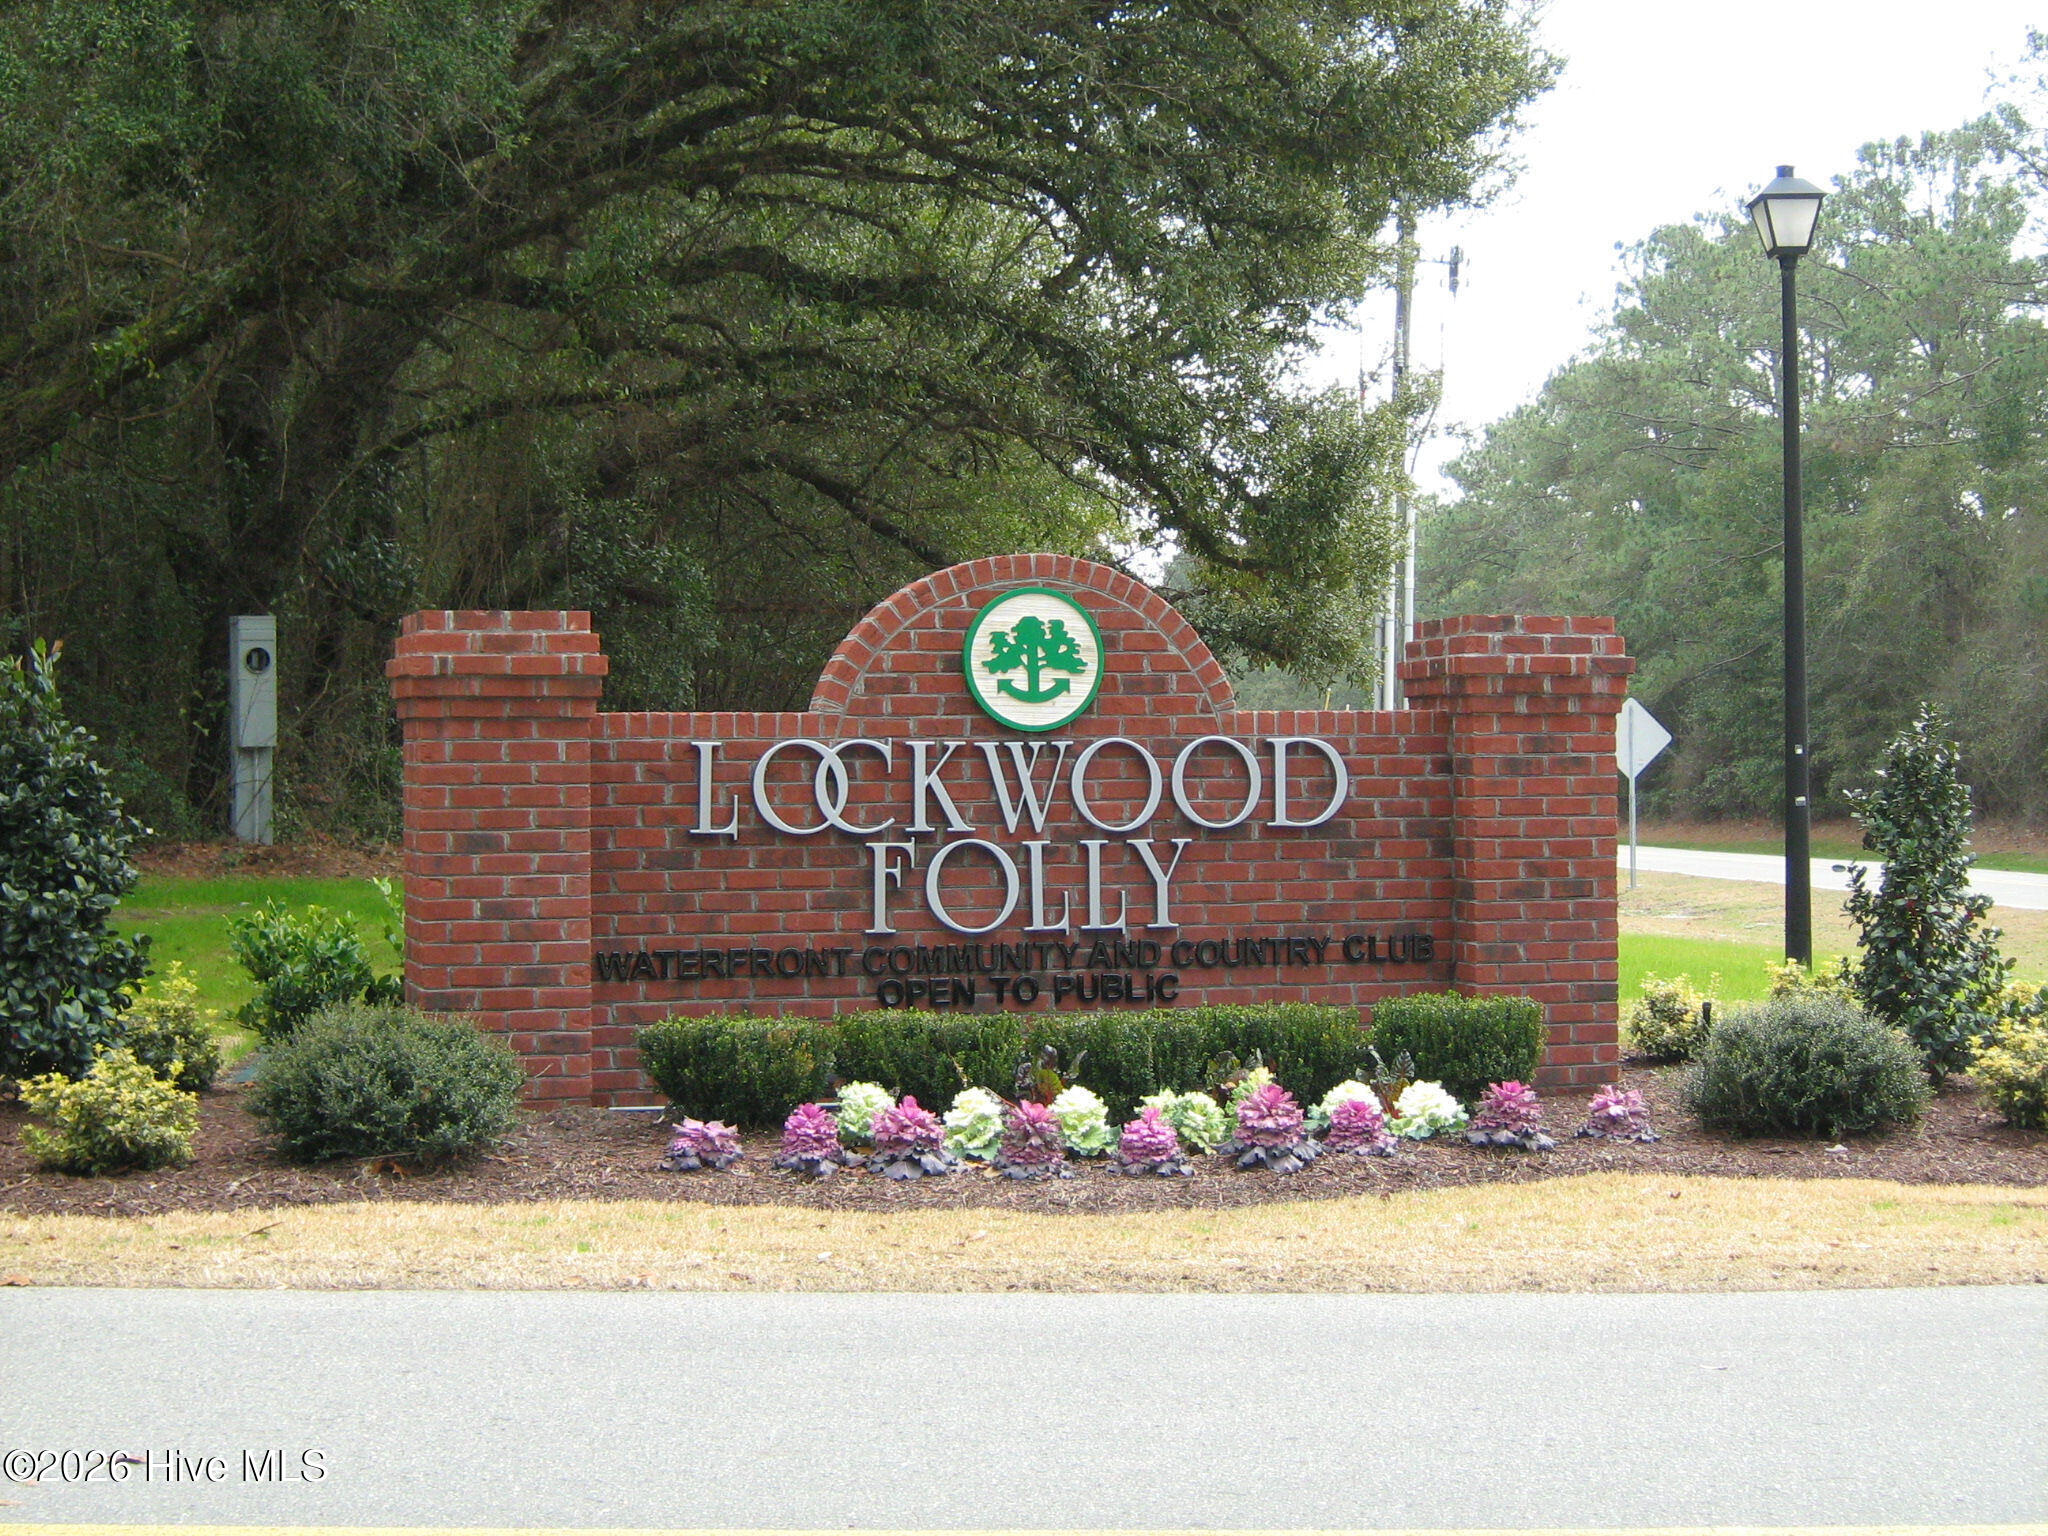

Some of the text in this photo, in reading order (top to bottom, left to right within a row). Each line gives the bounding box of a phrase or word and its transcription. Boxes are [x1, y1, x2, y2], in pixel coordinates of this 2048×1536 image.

[690, 735, 1349, 840] LOCKWOOD
[865, 837, 1193, 935] FOLLY
[597, 932, 1435, 981] WATERFRONT COMMUNITY AND COUNTRY CLUB
[877, 973, 1180, 1008] OPEN TO PUBLIC
